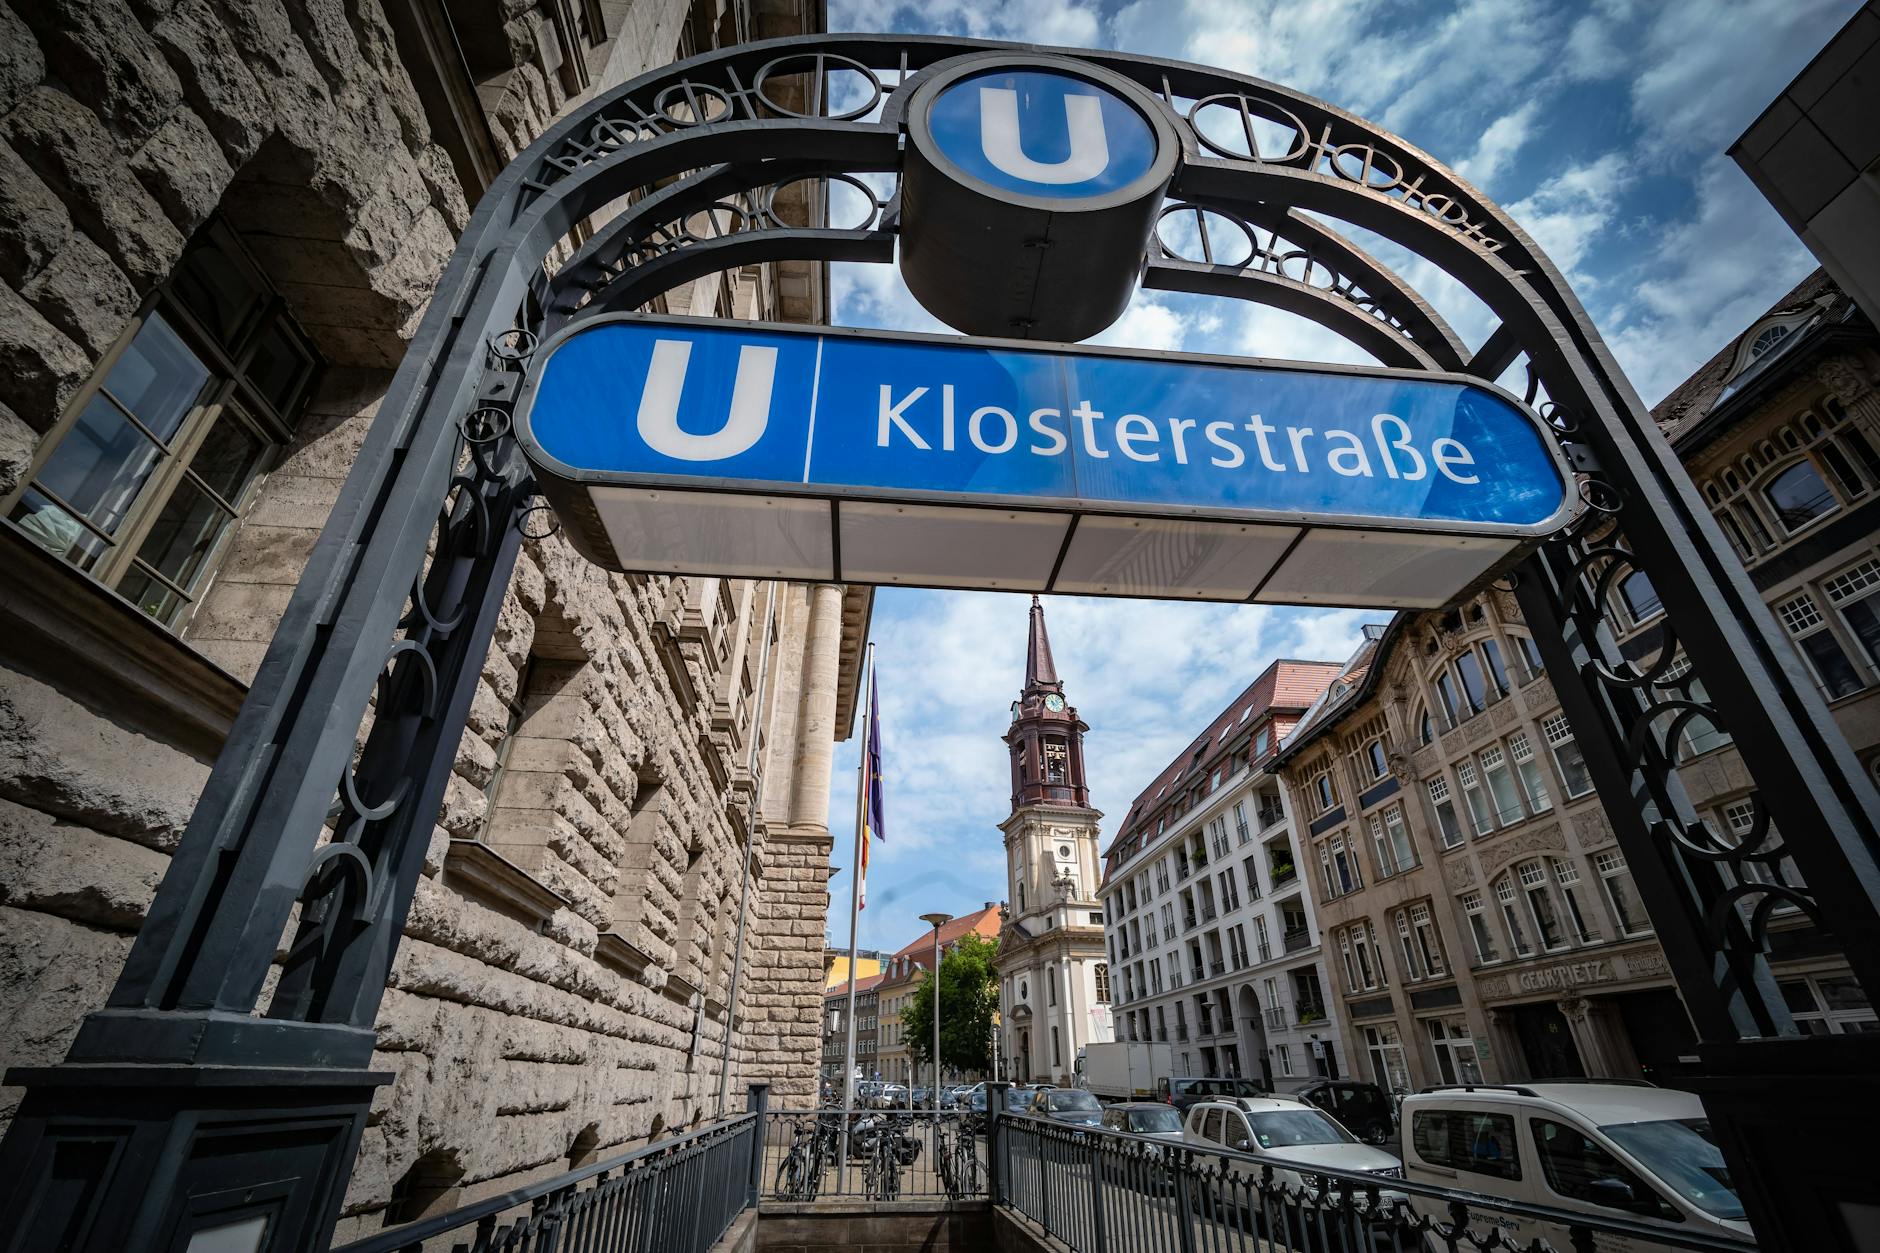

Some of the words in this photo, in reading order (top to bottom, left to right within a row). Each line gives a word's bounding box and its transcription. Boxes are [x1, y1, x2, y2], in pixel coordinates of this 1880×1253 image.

[980, 87, 1110, 185] U
[636, 339, 779, 461] U
[877, 383, 1481, 485] Klosterstraße
